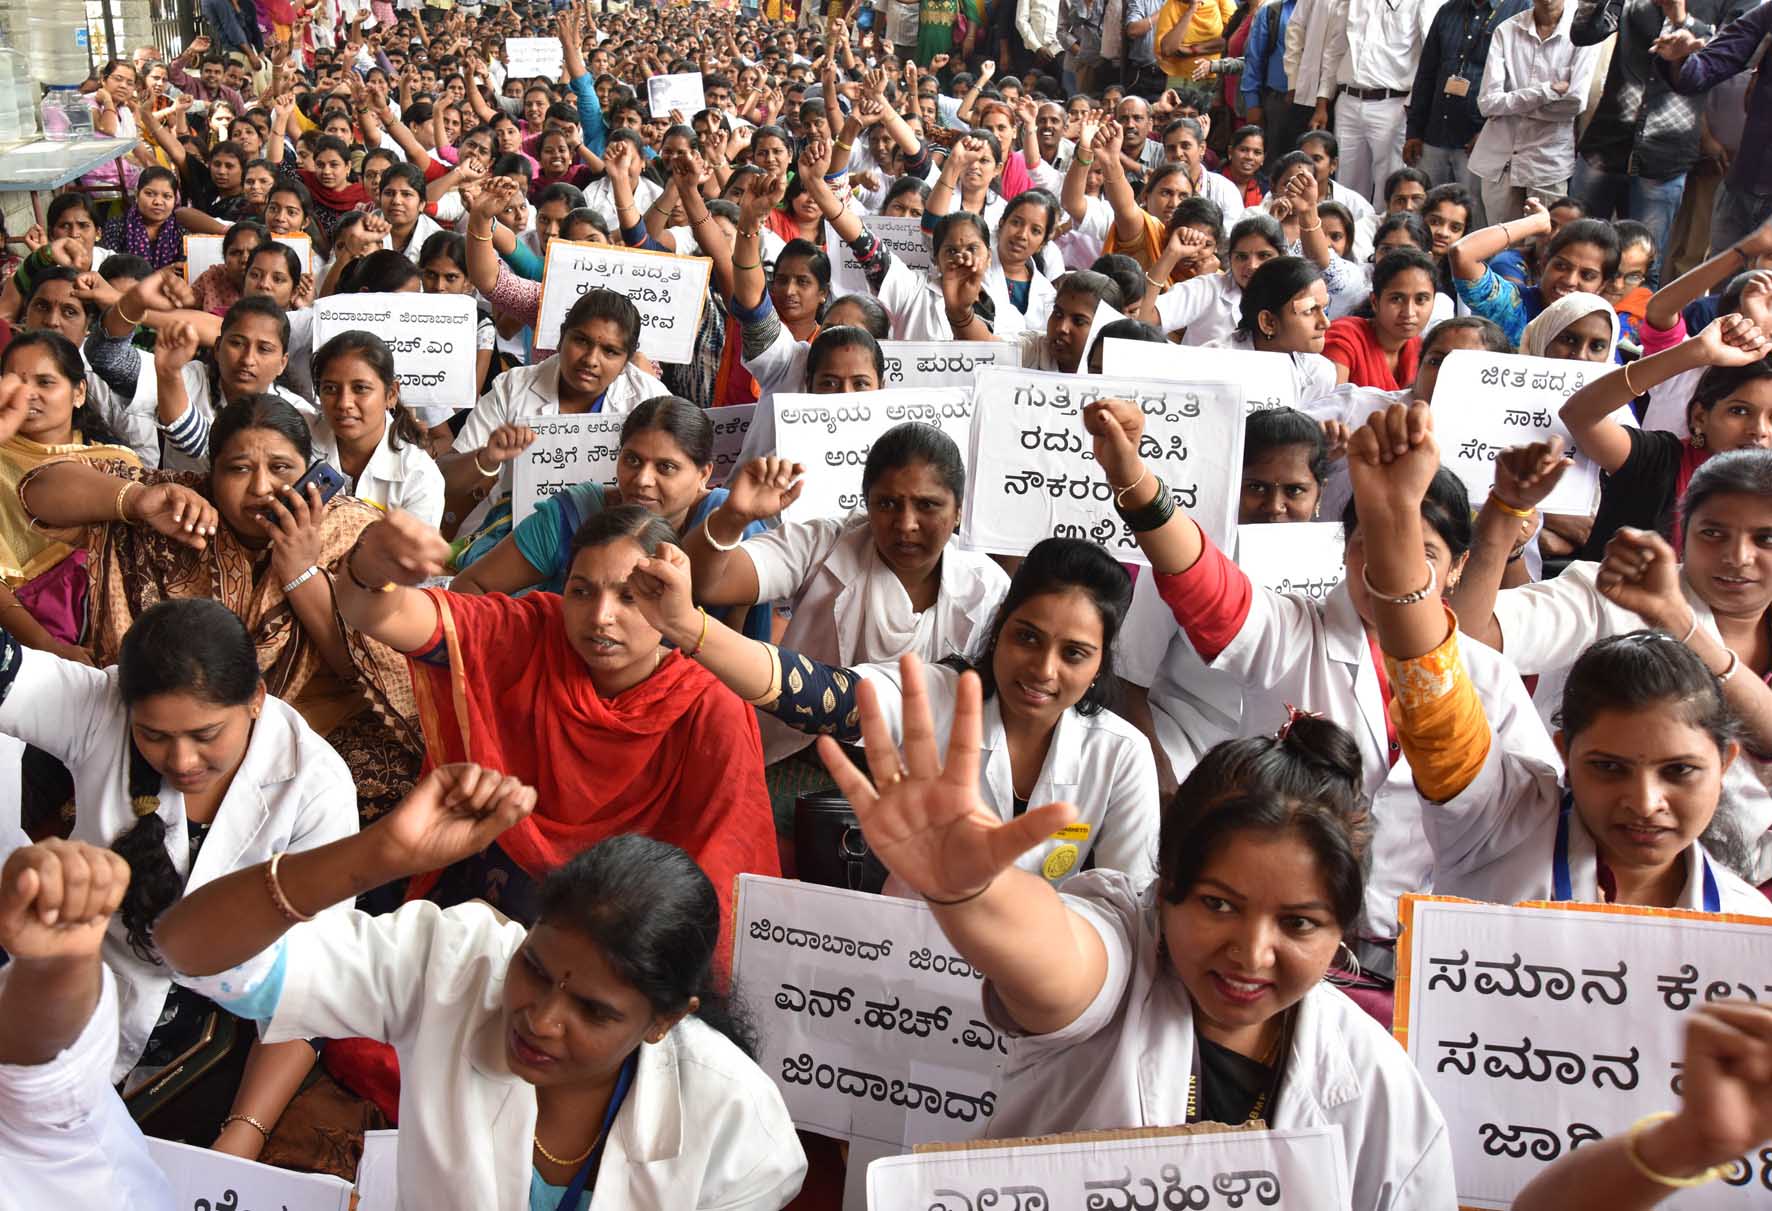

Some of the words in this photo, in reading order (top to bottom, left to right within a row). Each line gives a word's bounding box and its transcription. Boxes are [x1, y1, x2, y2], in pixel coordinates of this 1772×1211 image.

[320, 310, 391, 322] ಜಿಂದಾಬಾದ್
[399, 311, 469, 325] ಜಿಂದಾಬಾದ್
[1481, 366, 1528, 388] ಜೀತ
[781, 405, 872, 434] ಅನ್ಯಾಯ
[1503, 408, 1552, 428] ಸಾಕು
[531, 447, 578, 470] ಗುತ್ತಿಗೆ
[1020, 425, 1095, 460] ರದ್ದು
[1138, 434, 1188, 461] ಡಿಸಿ
[750, 918, 893, 961] ಜಿಂದಾಬಾದ್
[1428, 948, 1628, 1006] ಸಮಾನ
[1437, 1031, 1640, 1091] ಸಮಾನ
[781, 1053, 998, 1123] ಜಿಂದಾಬಾದ್
